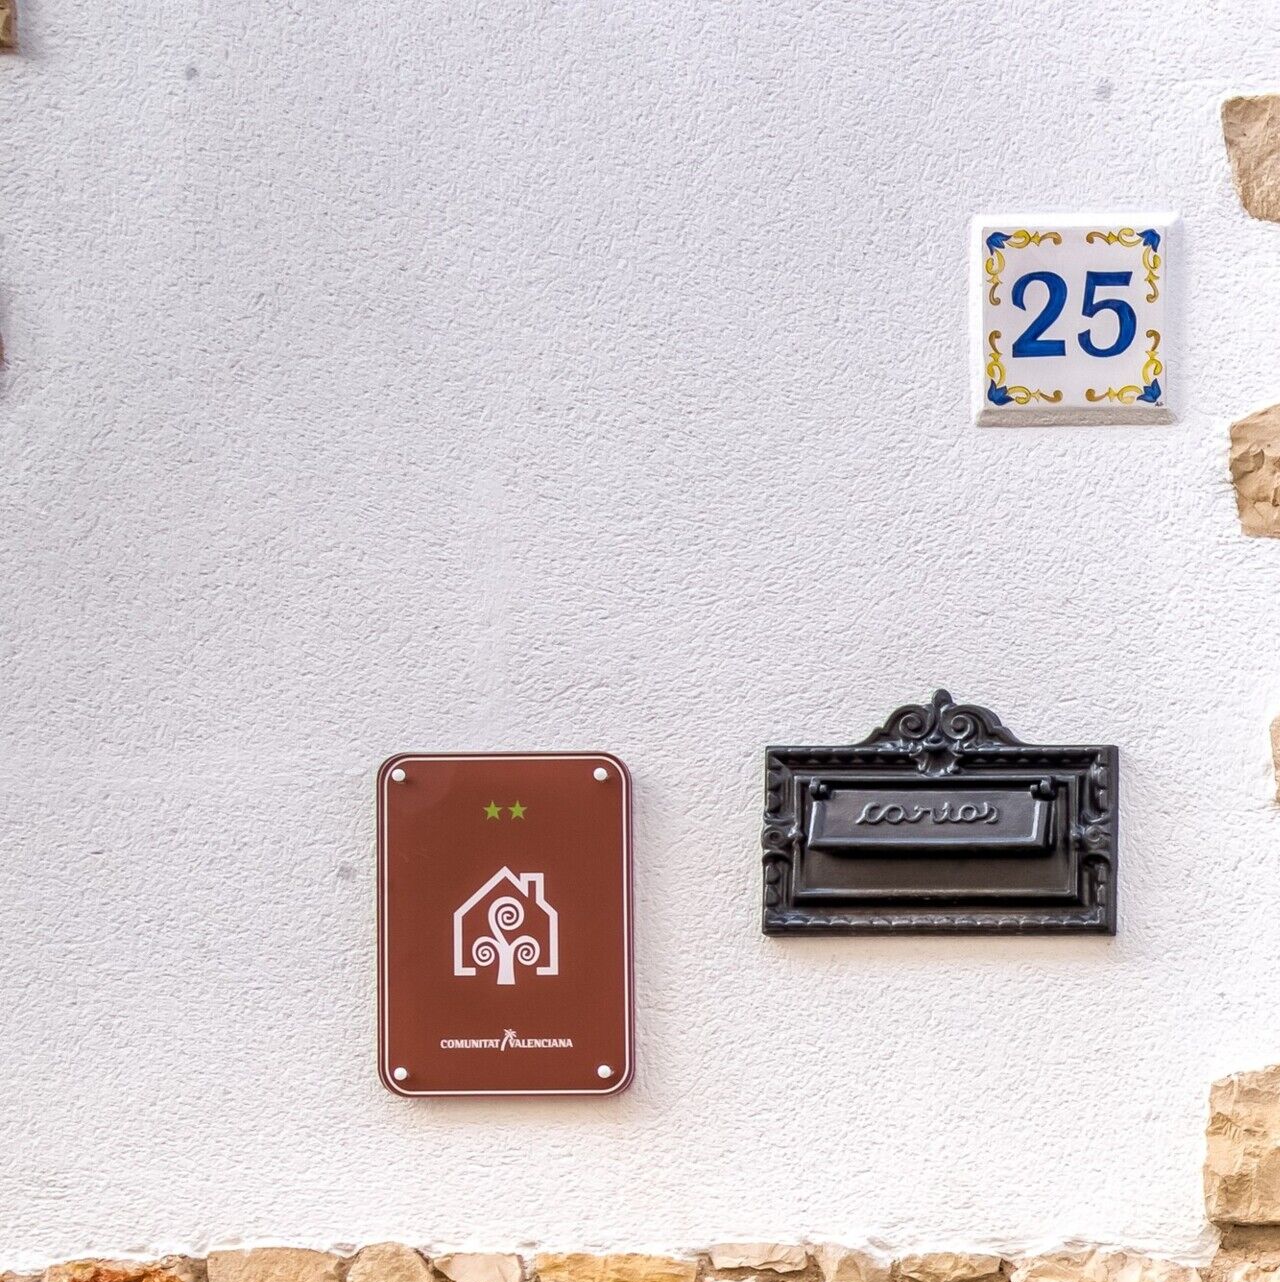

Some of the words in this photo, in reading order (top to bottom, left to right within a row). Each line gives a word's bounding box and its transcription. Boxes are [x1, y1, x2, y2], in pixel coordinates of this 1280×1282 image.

[1011, 270, 1137, 358] 25
[440, 1038, 501, 1049] COMUNITAT
[508, 1038, 573, 1048] VALENCIANA
